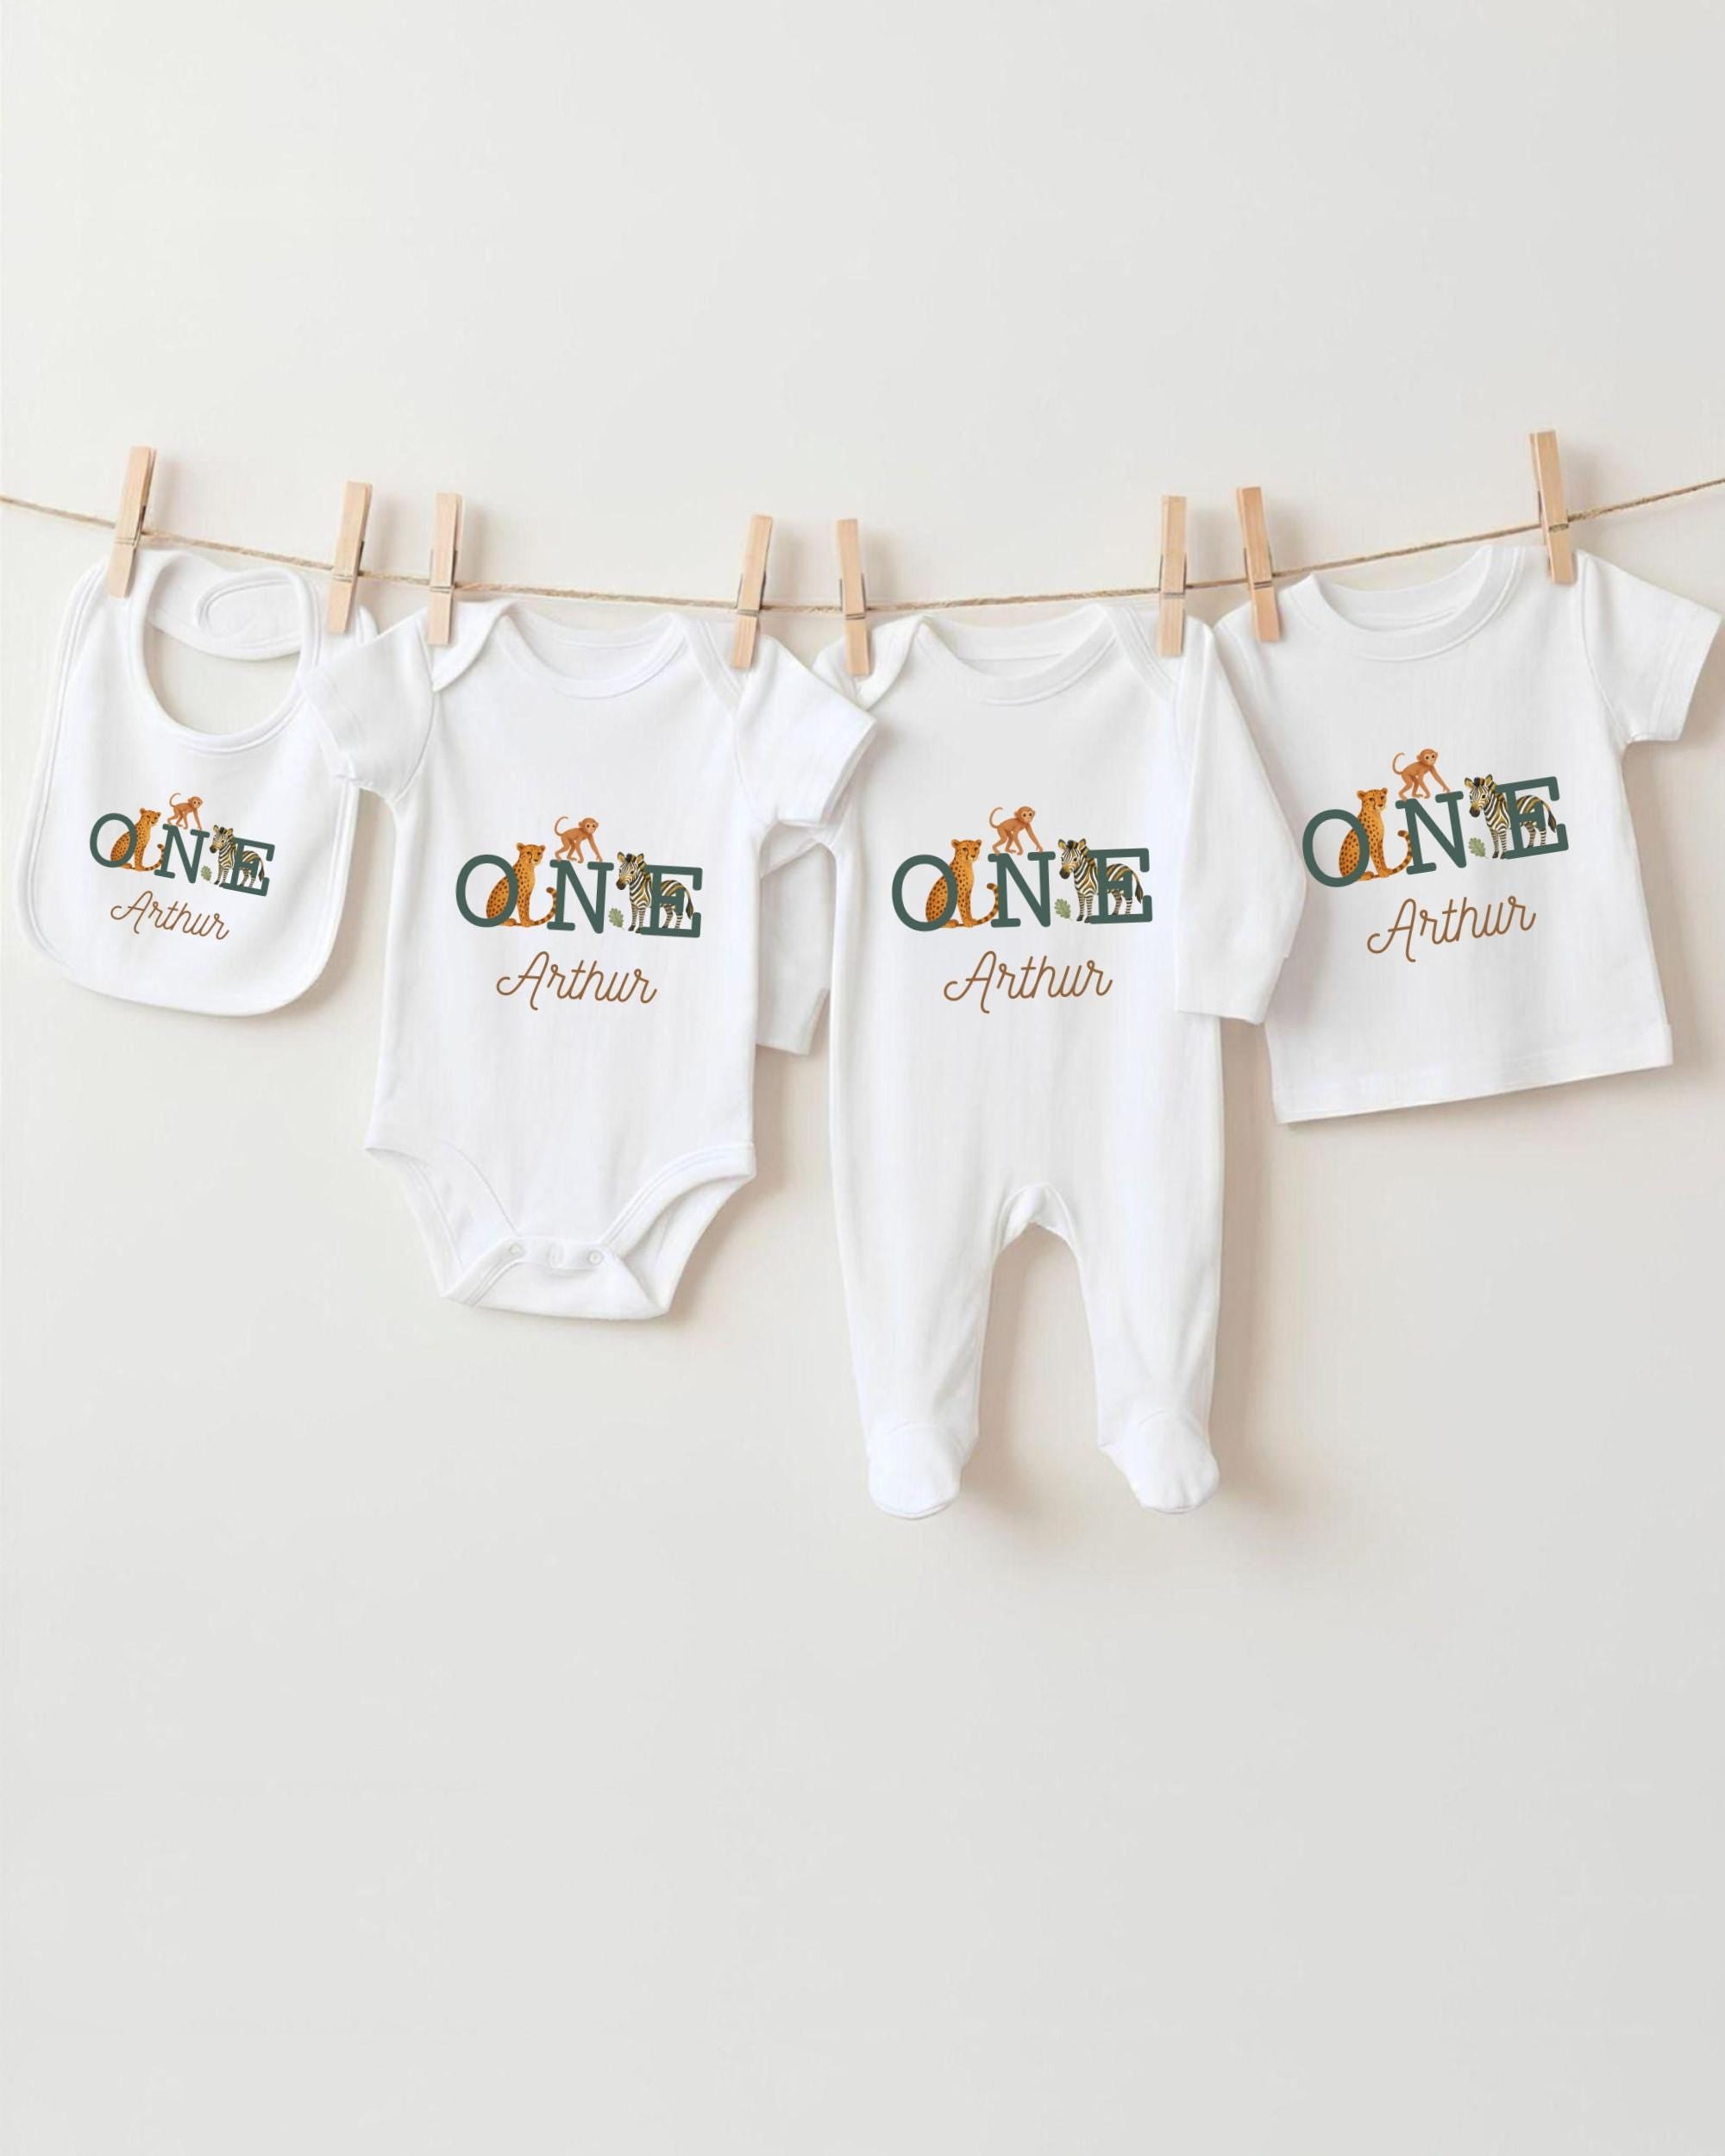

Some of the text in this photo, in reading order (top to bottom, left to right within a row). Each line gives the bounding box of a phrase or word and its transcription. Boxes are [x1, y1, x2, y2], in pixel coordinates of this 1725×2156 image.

[91, 813, 274, 896] ONE
[1302, 777, 1569, 887] ONE
[111, 891, 229, 940] Arthur
[456, 855, 702, 937] ONE
[892, 849, 1152, 931] ONE
[1367, 896, 1536, 962] Arthur
[497, 952, 657, 1011] Arthur
[944, 951, 1113, 1013] Arthur
